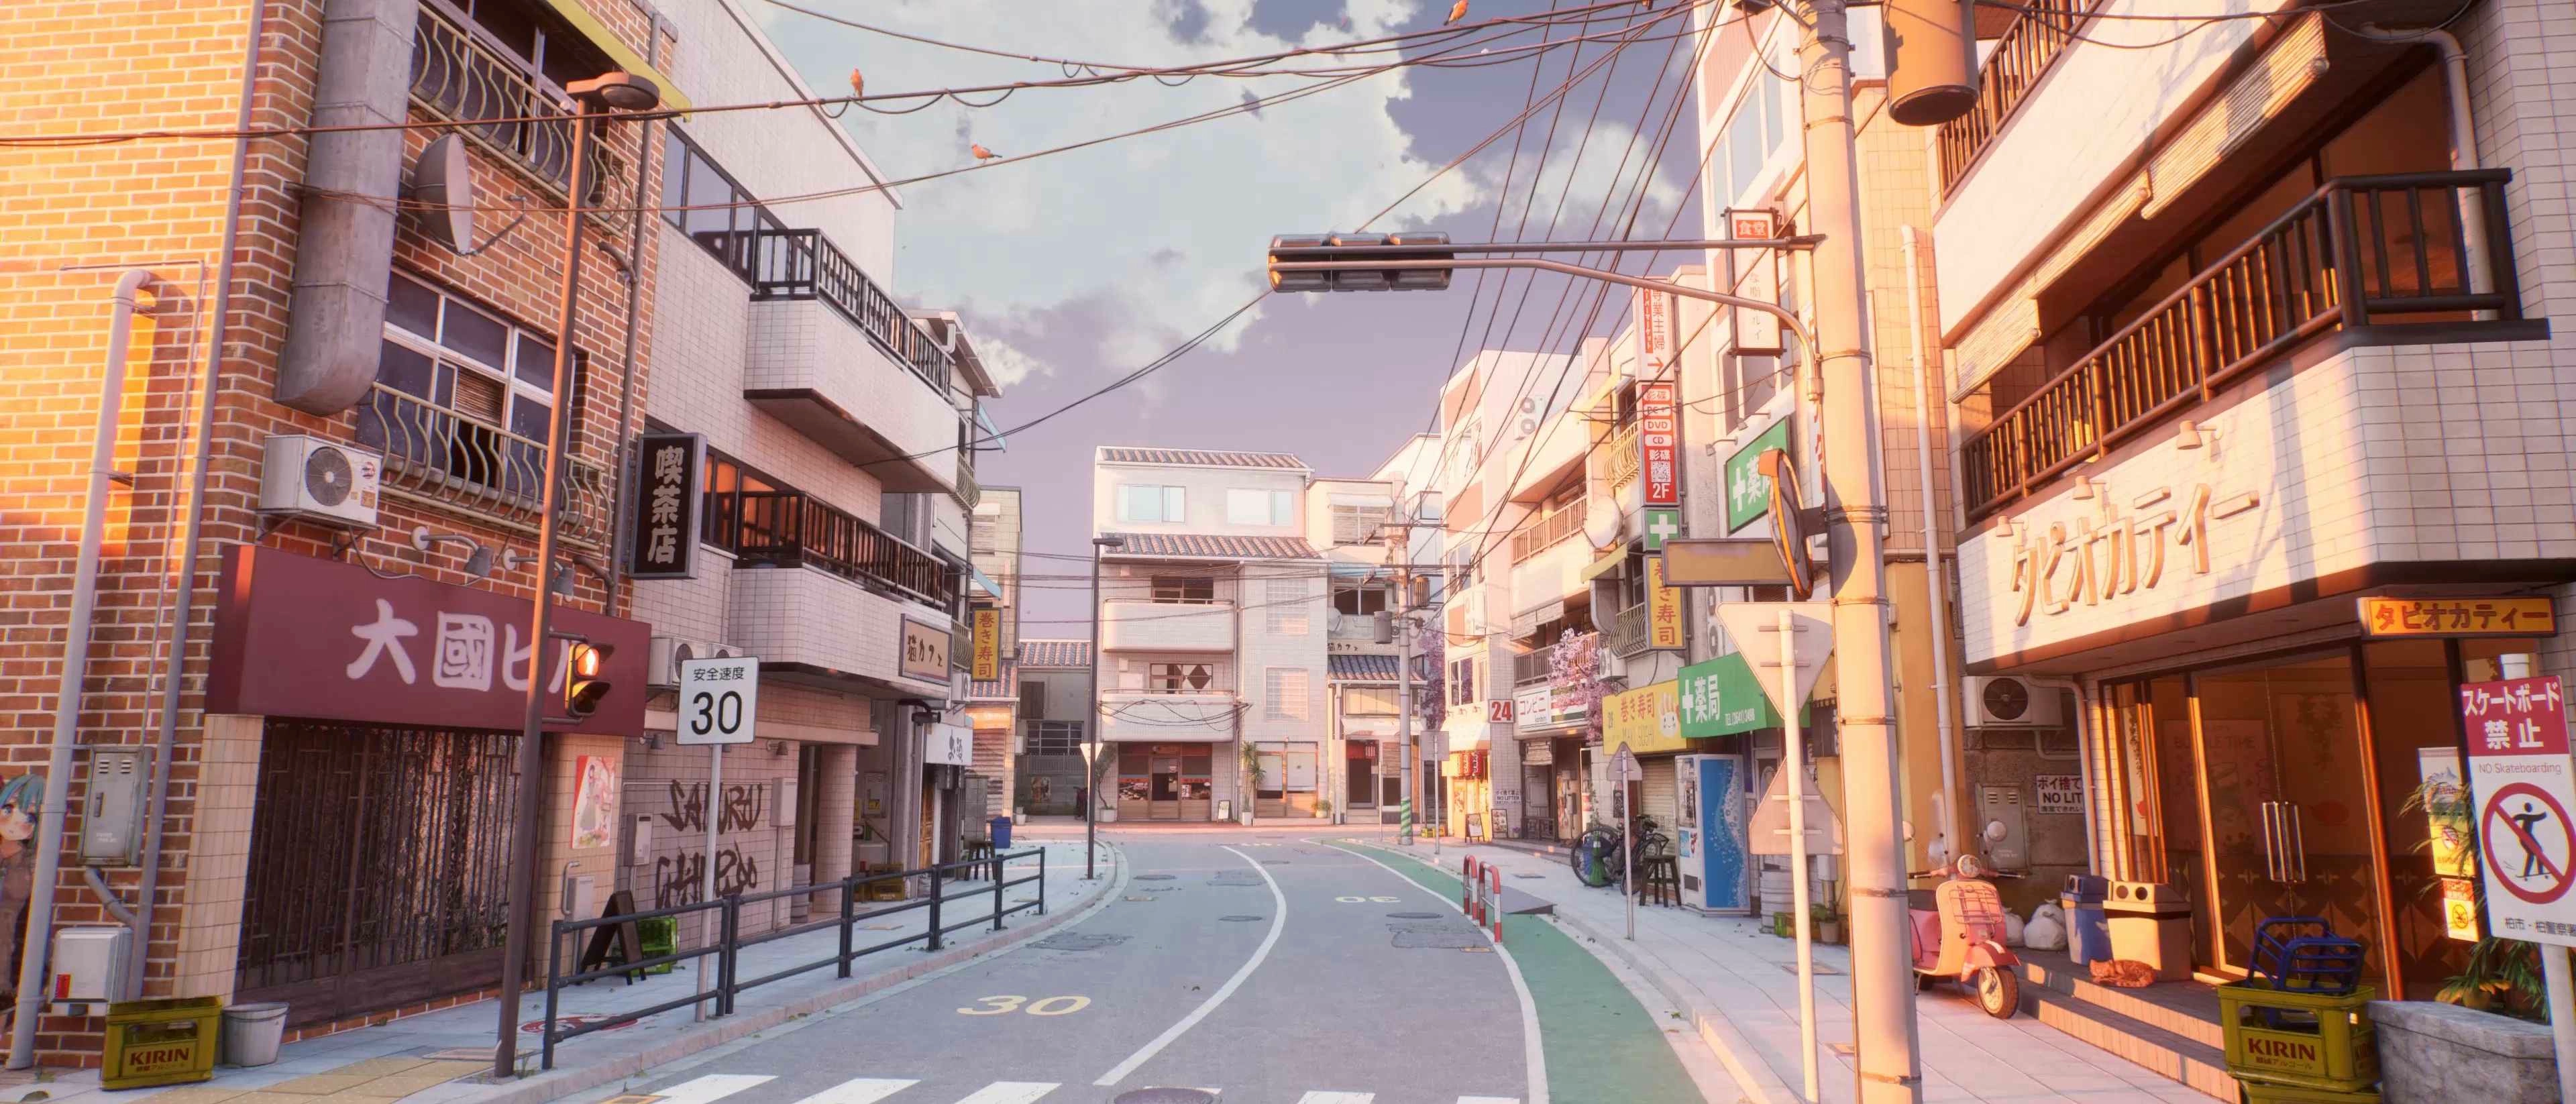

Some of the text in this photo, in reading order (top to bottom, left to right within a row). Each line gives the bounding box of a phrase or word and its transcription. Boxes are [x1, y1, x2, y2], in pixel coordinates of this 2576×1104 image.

[1739, 221, 1766, 235] 食堂
[1644, 288, 1653, 350] ーパーマーケット
[1648, 421, 1668, 429] DVD
[1652, 437, 1664, 445] CD
[1652, 483, 1670, 499] 2F
[647, 445, 684, 564] 喫茶店
[2010, 482, 2261, 627] タピオカティー
[2375, 602, 2548, 630] タピオカティー
[977, 612, 995, 678] 巻き寿司
[693, 667, 745, 682] 安全速度
[1519, 697, 1546, 716] コンビニ
[1620, 692, 1655, 723] 巻き寿司
[1694, 673, 1721, 724] 薬局
[2462, 681, 2561, 717] スケートボード
[691, 691, 743, 735] 30
[1491, 700, 1512, 722] 24
[2484, 717, 2544, 750] 禁止
[2479, 762, 2561, 775] NO Skateboarding
[2043, 792, 2061, 804] NO
[956, 995, 1091, 1016] 30
[129, 1047, 190, 1066] KIRIN
[2248, 1038, 2316, 1061] KIRIN
